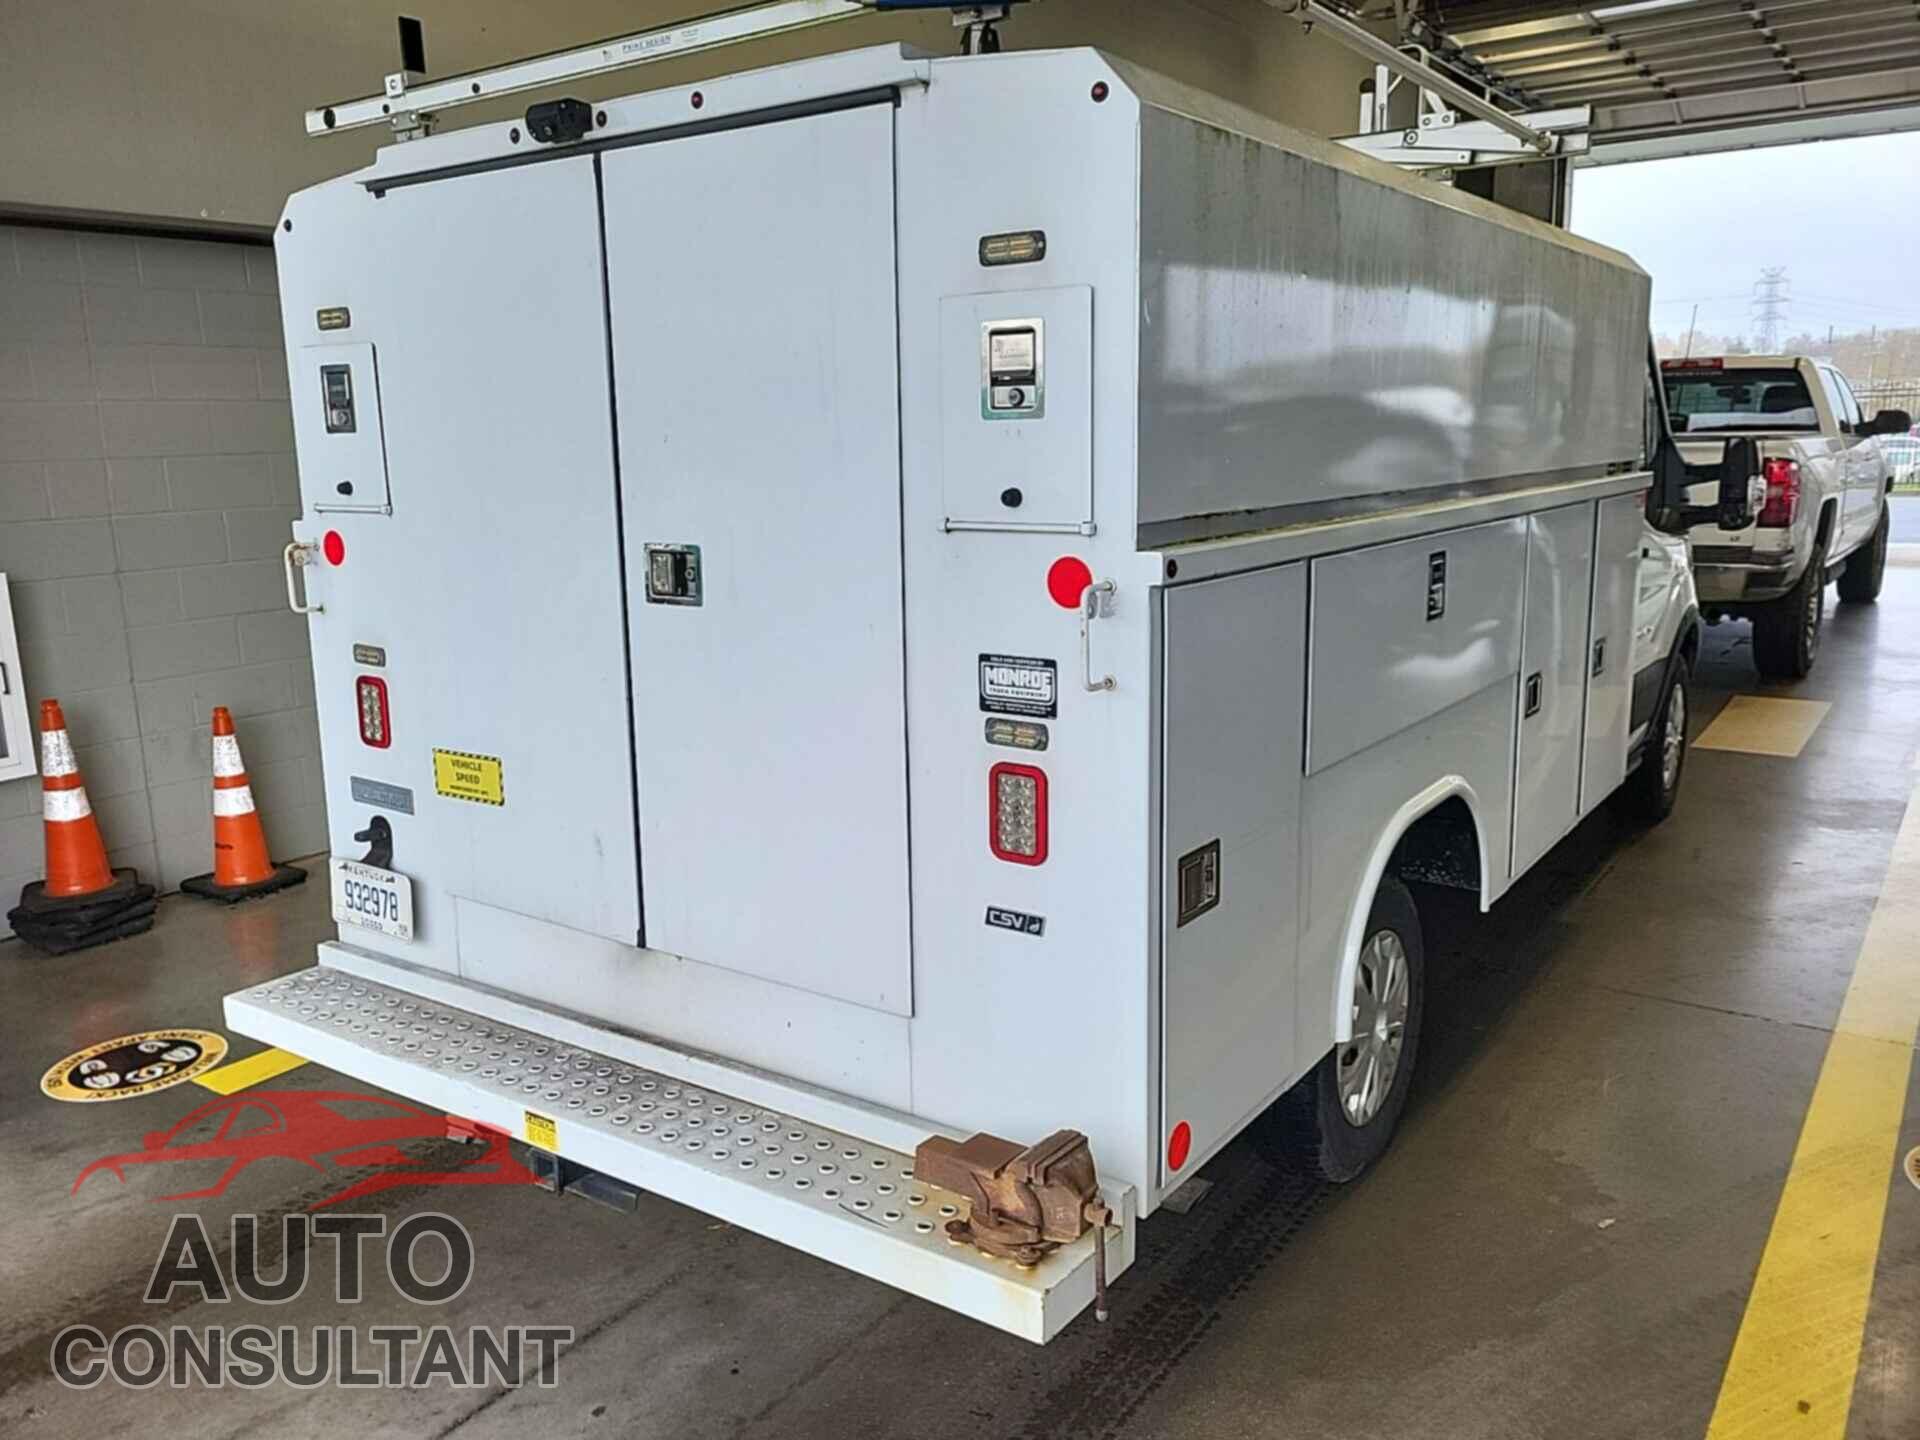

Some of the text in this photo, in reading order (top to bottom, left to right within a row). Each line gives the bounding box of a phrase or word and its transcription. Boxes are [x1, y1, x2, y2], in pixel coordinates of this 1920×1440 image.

[984, 666, 1053, 690] MONROE
[450, 759, 482, 772] VEHICLE
[455, 772, 481, 785] SPEED
[345, 879, 399, 922] 932978
[989, 910, 1023, 928] CSV
